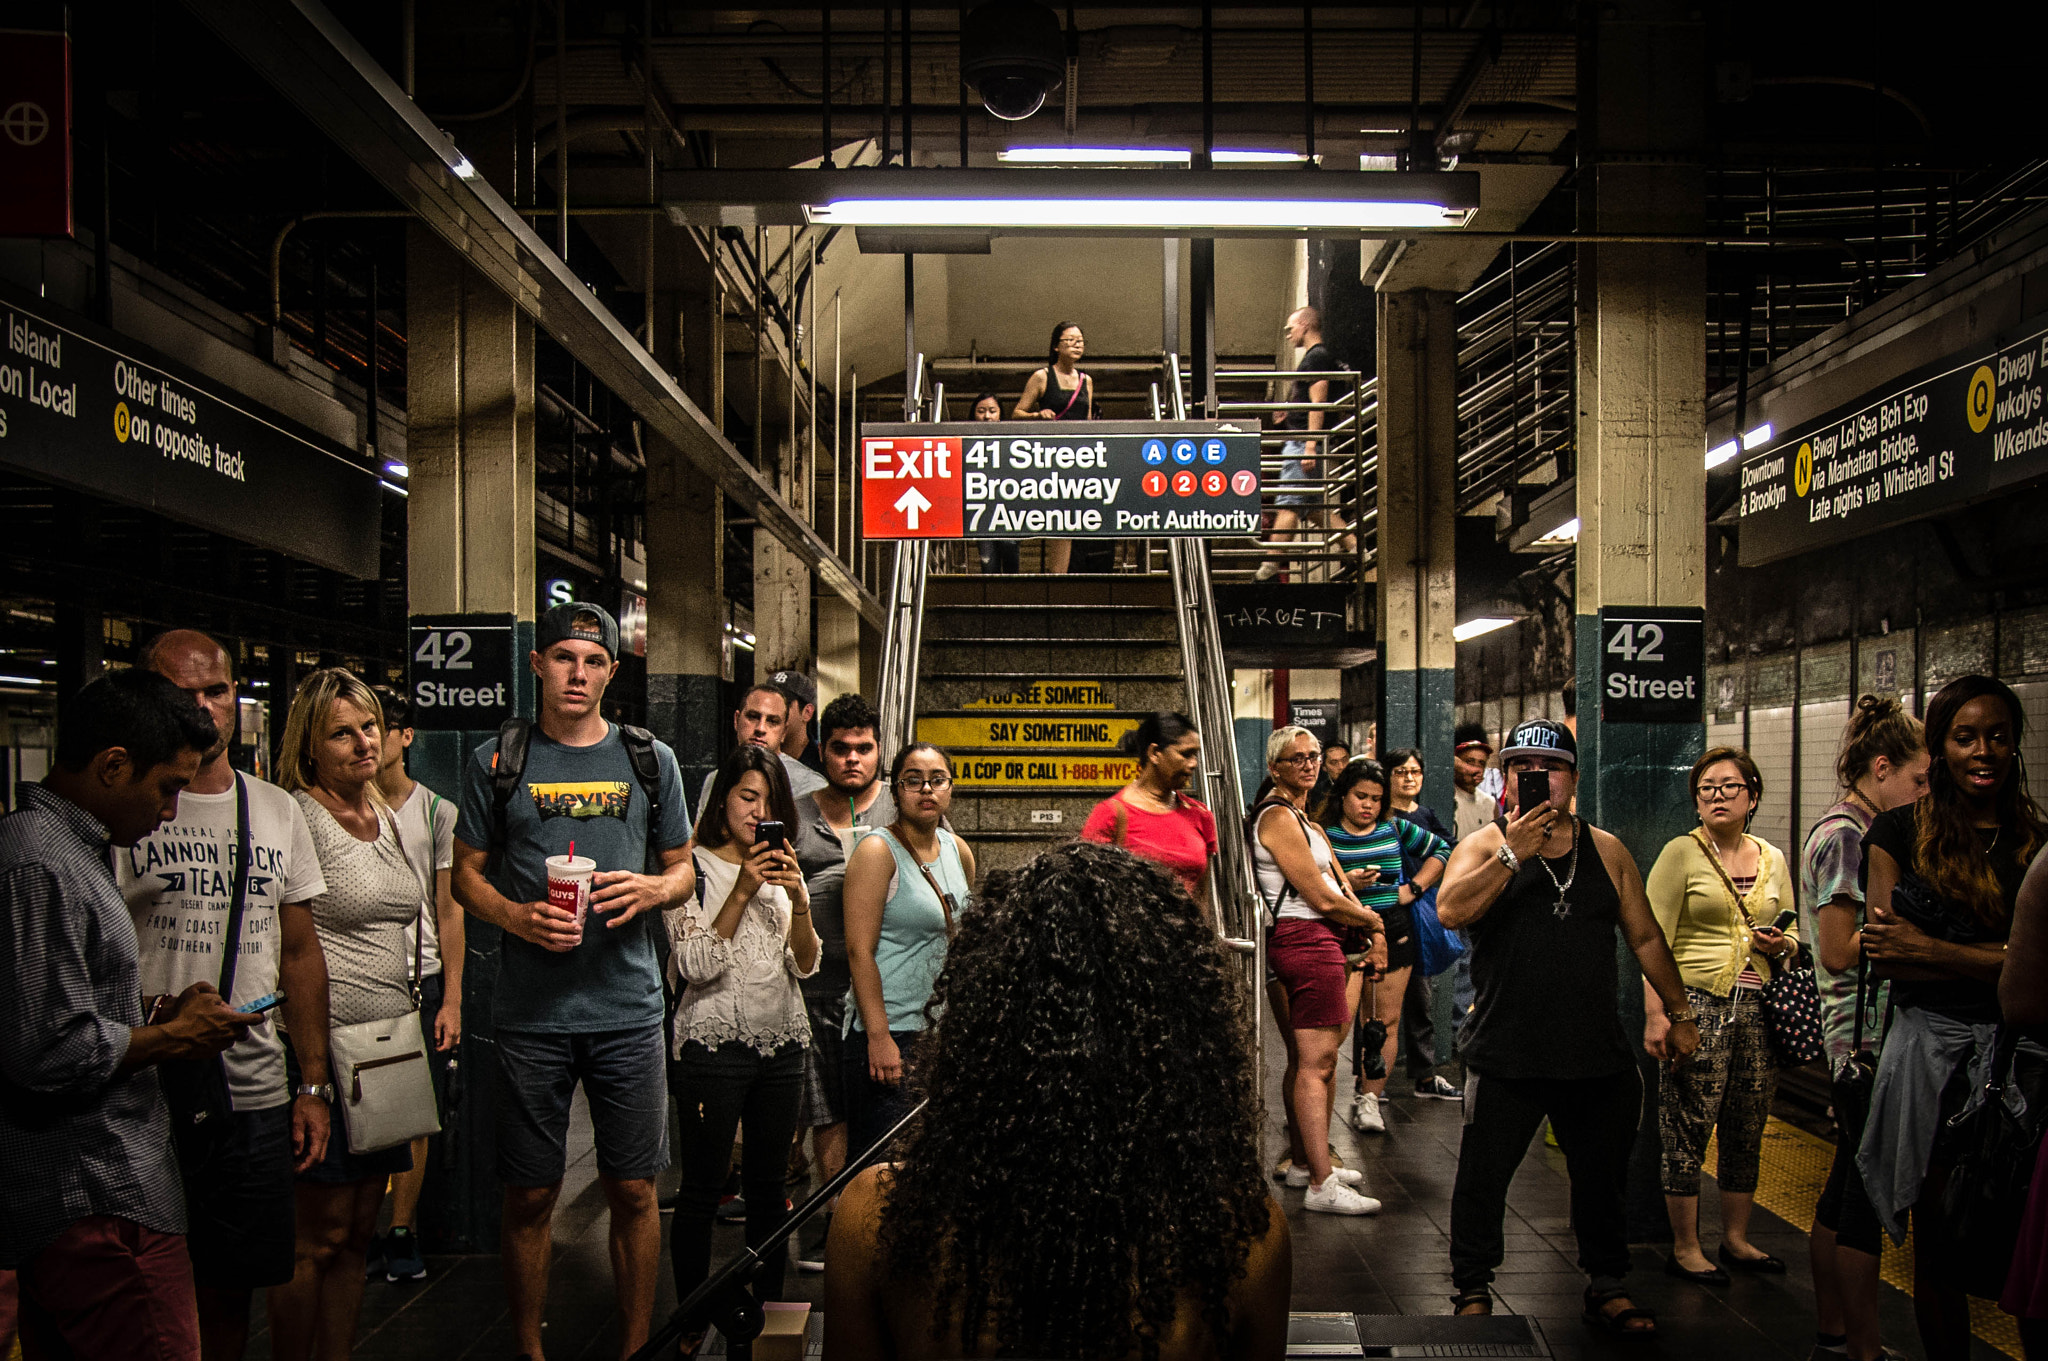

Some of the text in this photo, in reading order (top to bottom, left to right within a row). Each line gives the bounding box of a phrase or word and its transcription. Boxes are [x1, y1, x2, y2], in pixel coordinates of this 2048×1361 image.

[9, 312, 61, 369] Island
[1997, 350, 2037, 388] Bway
[29, 365, 77, 418] Local
[114, 360, 197, 425] Other times
[1996, 384, 2042, 424] wkdys
[1812, 393, 1930, 463] Bway Lcl/Sea Bch Exp
[1993, 416, 2048, 462] Wkends
[131, 415, 151, 445] on
[155, 423, 212, 469] opposite
[215, 443, 246, 483] track
[866, 441, 952, 479] Exit
[965, 440, 1108, 469] 41 Street
[1812, 433, 1920, 492] via Manhattan Bridge.
[965, 472, 1121, 504] Broadway
[1740, 456, 1786, 490] Downtown
[1809, 450, 1955, 523] Late nights via Whitehall St
[1740, 484, 1787, 518] & Brooklyn
[965, 504, 1102, 532] 7 Avenue
[1117, 509, 1260, 534] Port Authority
[549, 578, 574, 607] S
[415, 631, 473, 670] 42
[1607, 623, 1664, 662] 42
[416, 681, 507, 708] Street
[1606, 672, 1696, 700] Street
[1293, 707, 1322, 717] Times
[1293, 716, 1326, 727] Square
[990, 723, 1113, 743] SAY SOMETHING.
[1516, 726, 1560, 749] SPORT
[961, 763, 972, 779] A
[975, 763, 1001, 779] COP
[1005, 763, 1024, 779] OR
[1028, 763, 1058, 779] CALL
[163, 826, 215, 838] MCNEAL
[130, 842, 219, 878] CANNON
[181, 900, 203, 910] DESERT
[550, 889, 575, 900] GUYS
[146, 914, 273, 935] FROM COAST COAST
[161, 936, 211, 953] SOUTHERN
